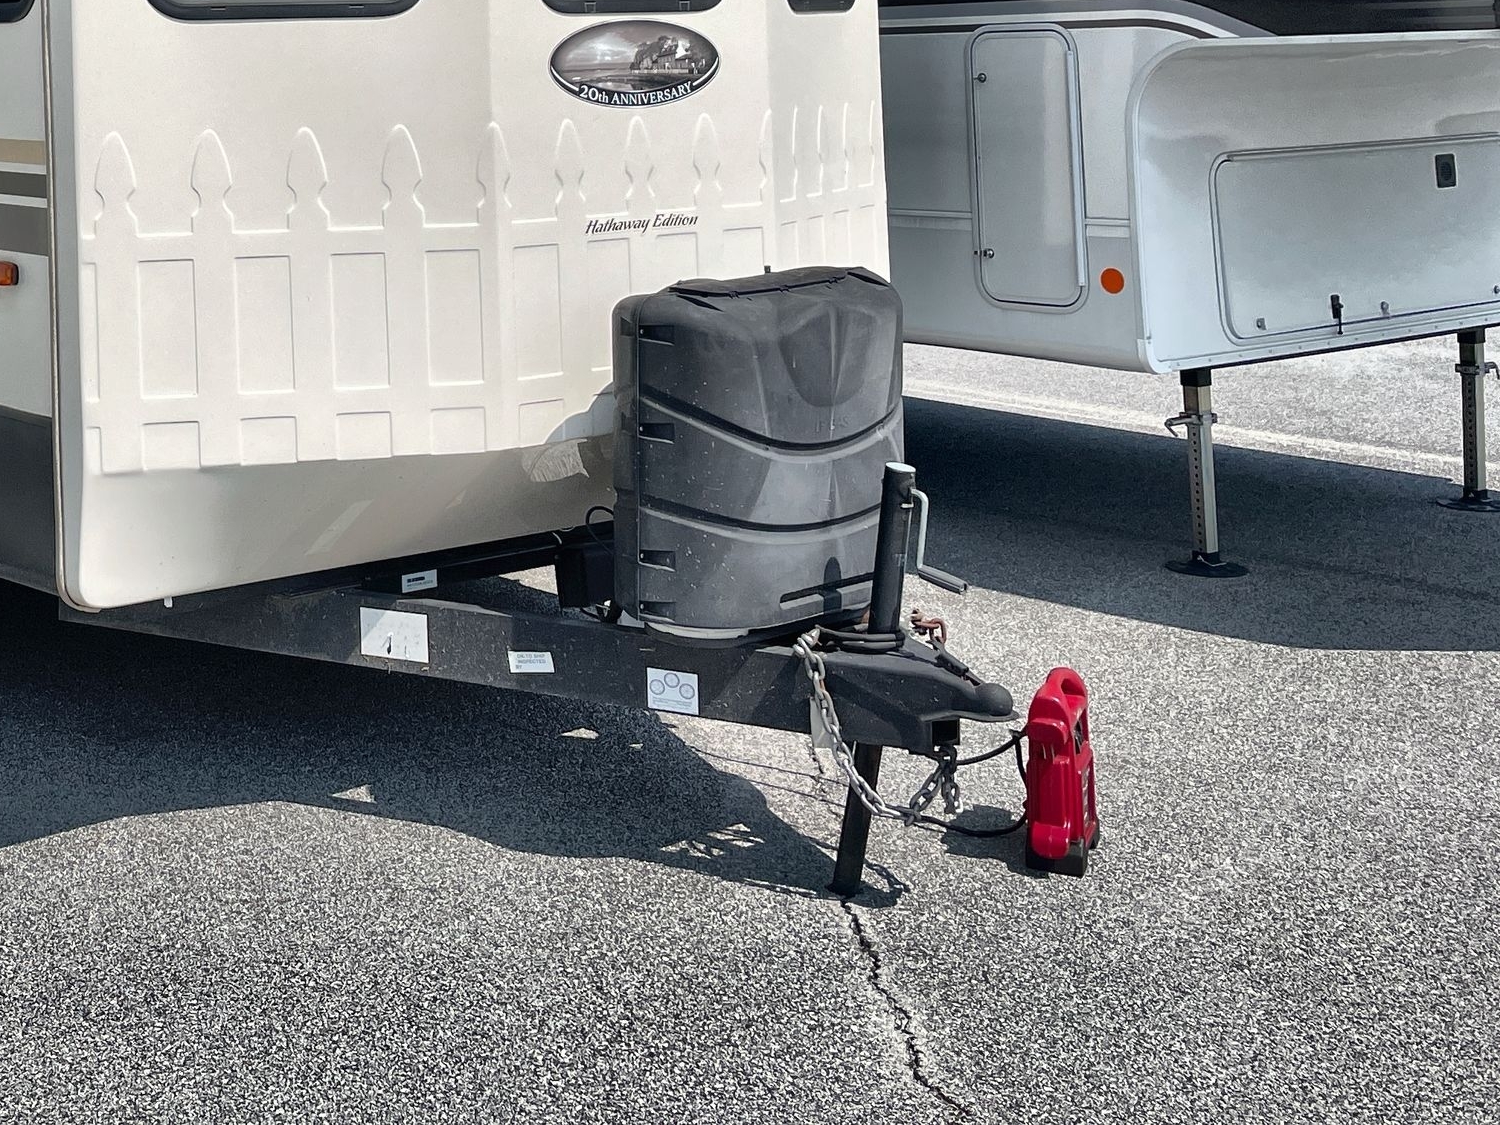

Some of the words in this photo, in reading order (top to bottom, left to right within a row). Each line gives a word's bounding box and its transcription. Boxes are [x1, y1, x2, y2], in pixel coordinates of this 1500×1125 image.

[580, 84, 609, 103] 20th
[611, 81, 692, 105] ANNIVERSARY
[585, 218, 651, 234] Hathaway
[652, 213, 699, 228] Edition
